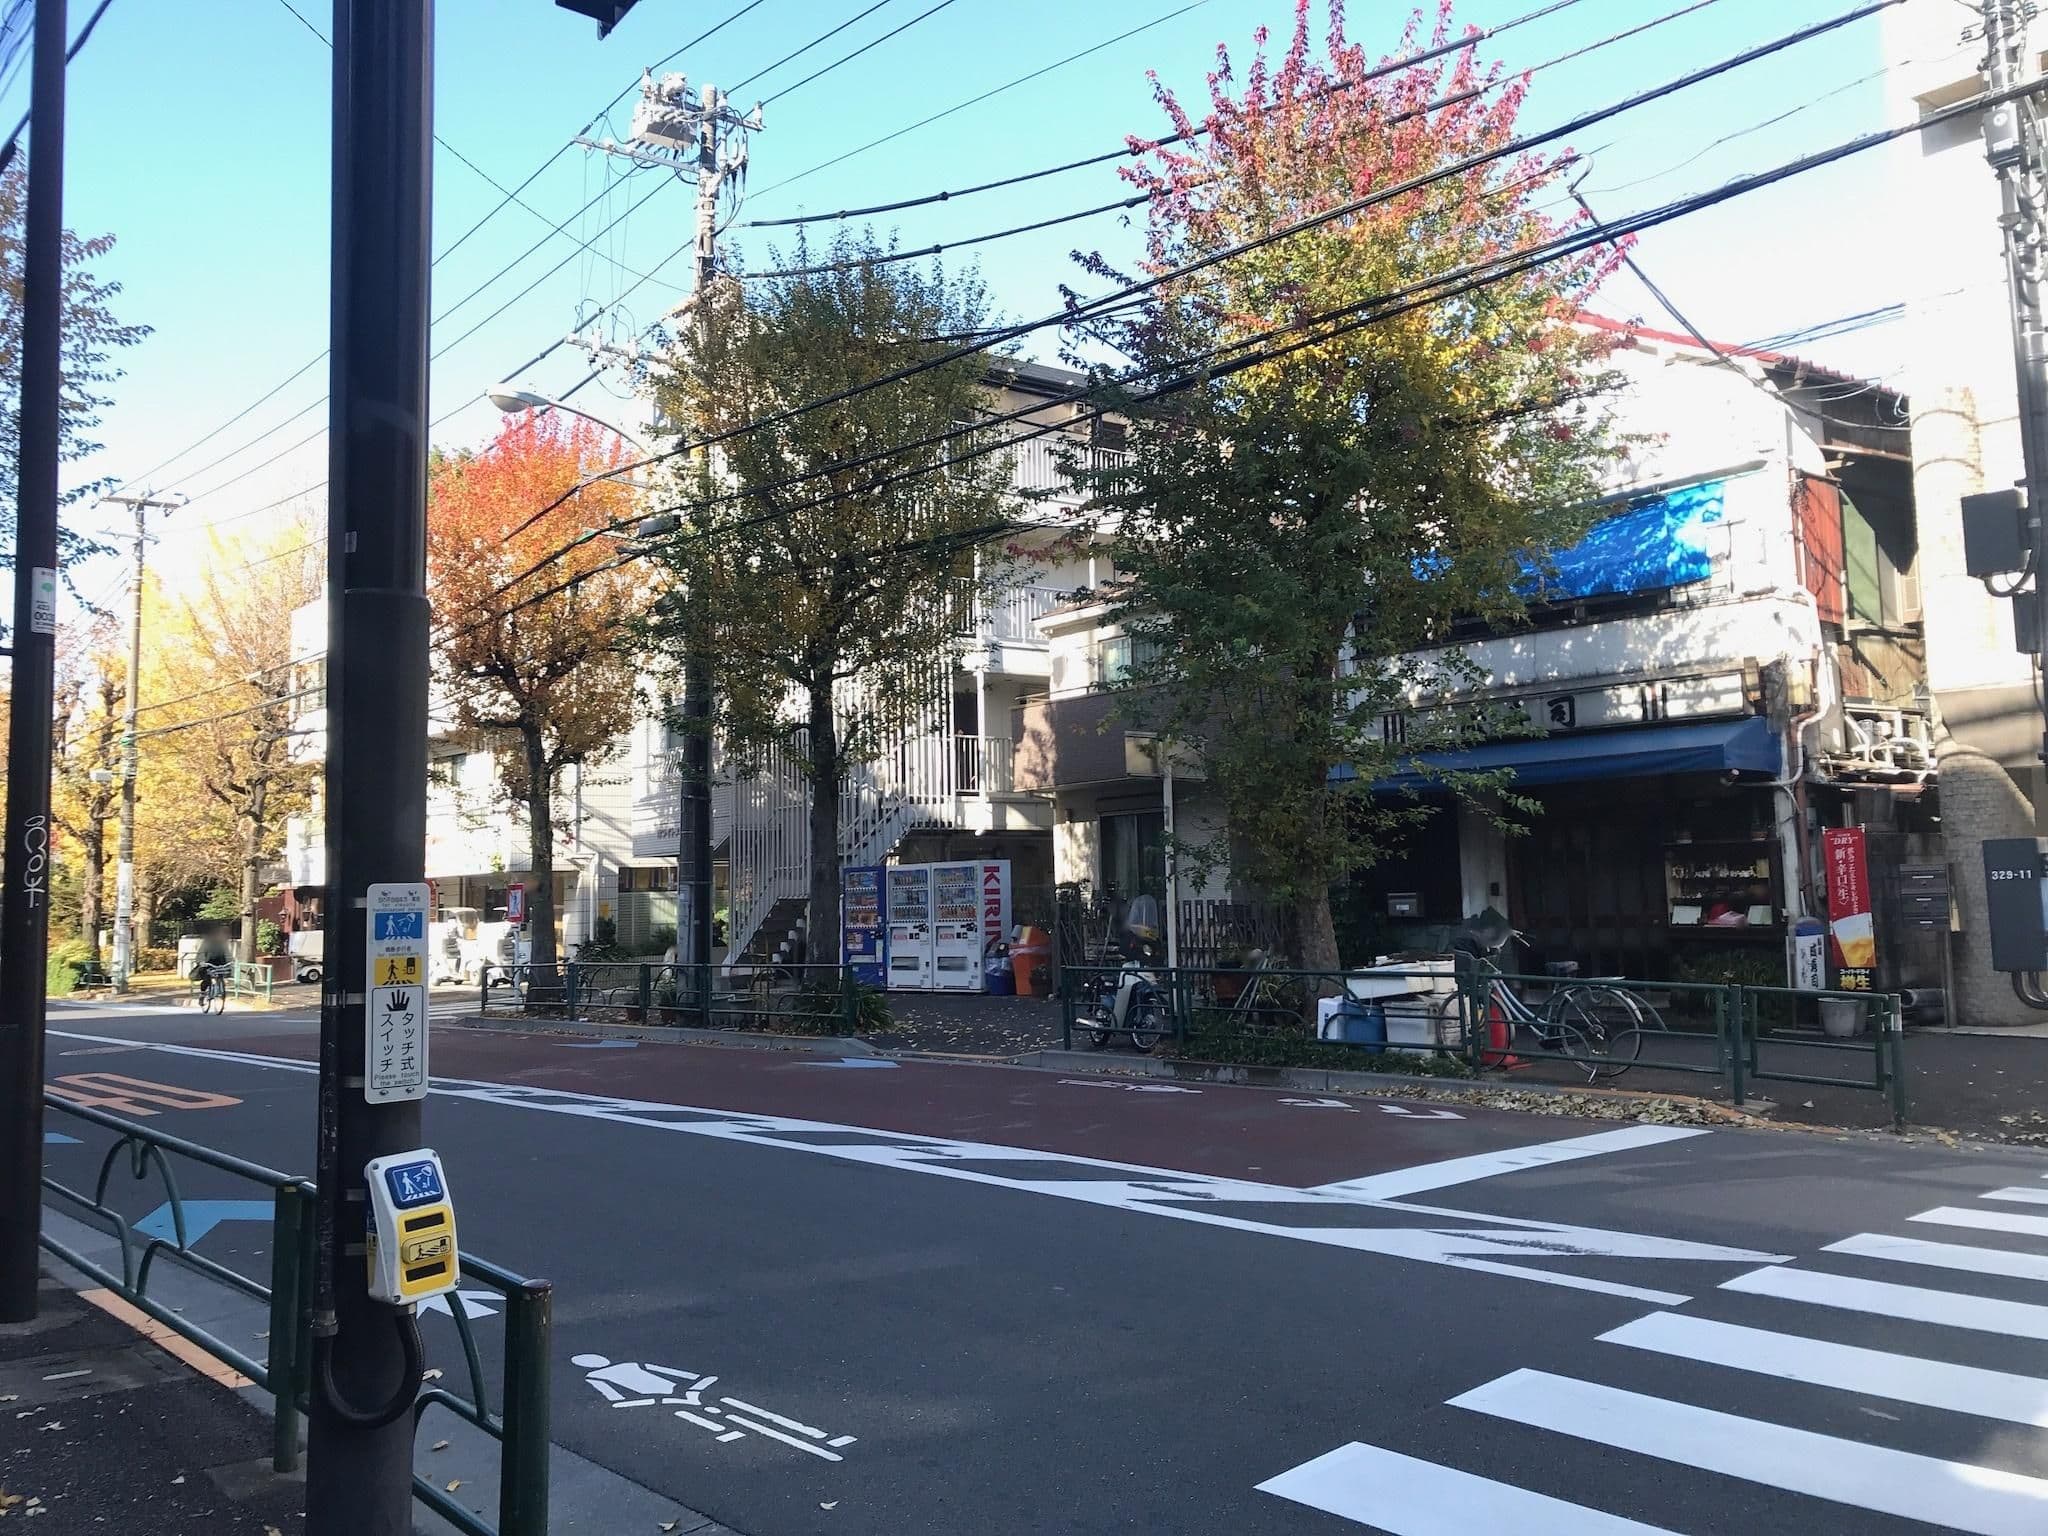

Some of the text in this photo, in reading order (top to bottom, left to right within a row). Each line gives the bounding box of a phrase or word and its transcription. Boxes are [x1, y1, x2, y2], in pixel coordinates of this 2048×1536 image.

[1546, 693, 1576, 728] 司
[1991, 869, 2032, 881] 329-11
[983, 865, 1002, 948] KIRIN
[380, 1013, 394, 1073] スイッチ
[400, 1012, 415, 1071] タッチ式
